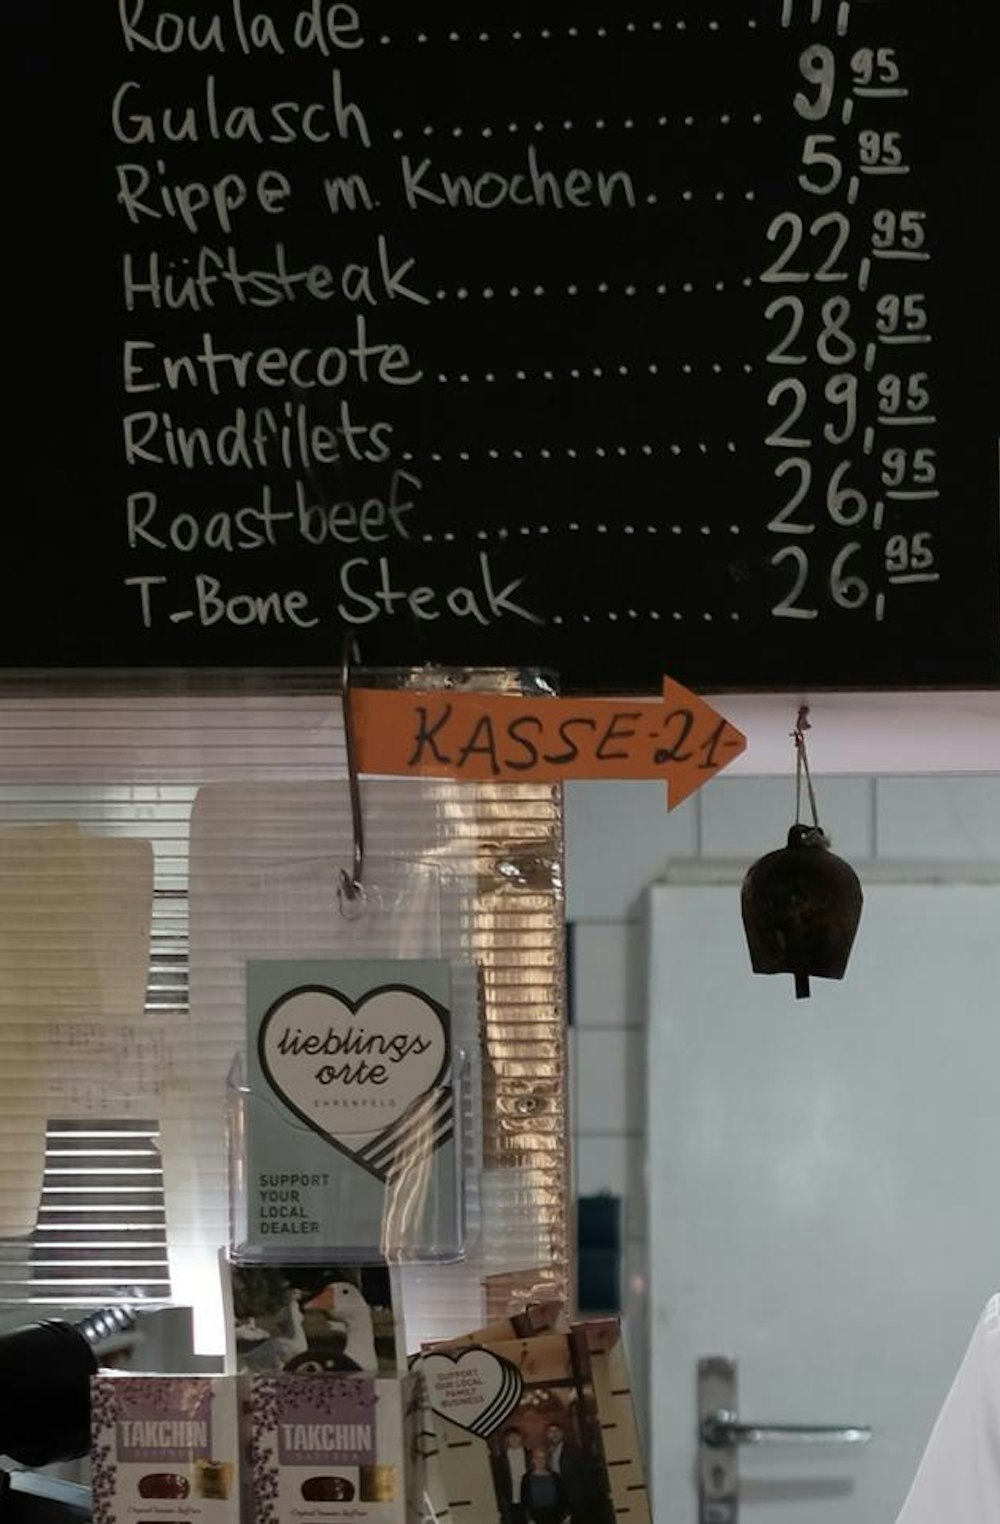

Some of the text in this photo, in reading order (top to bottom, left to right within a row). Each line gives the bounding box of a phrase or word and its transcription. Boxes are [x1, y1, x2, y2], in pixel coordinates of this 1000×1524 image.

[112, 69, 370, 147] Gulasch
[116, 160, 290, 232] Rippe
[402, 146, 635, 208] Knochen
[124, 235, 430, 311] Hüftsteak
[124, 315, 424, 394] Entrecote
[123, 405, 392, 468] Rindfilets
[127, 471, 421, 551] Roastbeef
[125, 574, 318, 627] T-Bone
[338, 552, 544, 625] Steak
[277, 1028, 431, 1062] lieblings
[314, 1061, 389, 1085] orte
[259, 1174, 330, 1186] SUPPORT
[259, 1190, 300, 1202] YOUR
[259, 1206, 308, 1218] LOCAL
[259, 1222, 320, 1234] DEALER
[120, 1420, 208, 1448] TAKCHIN
[282, 1423, 372, 1451] TAKCHIN
